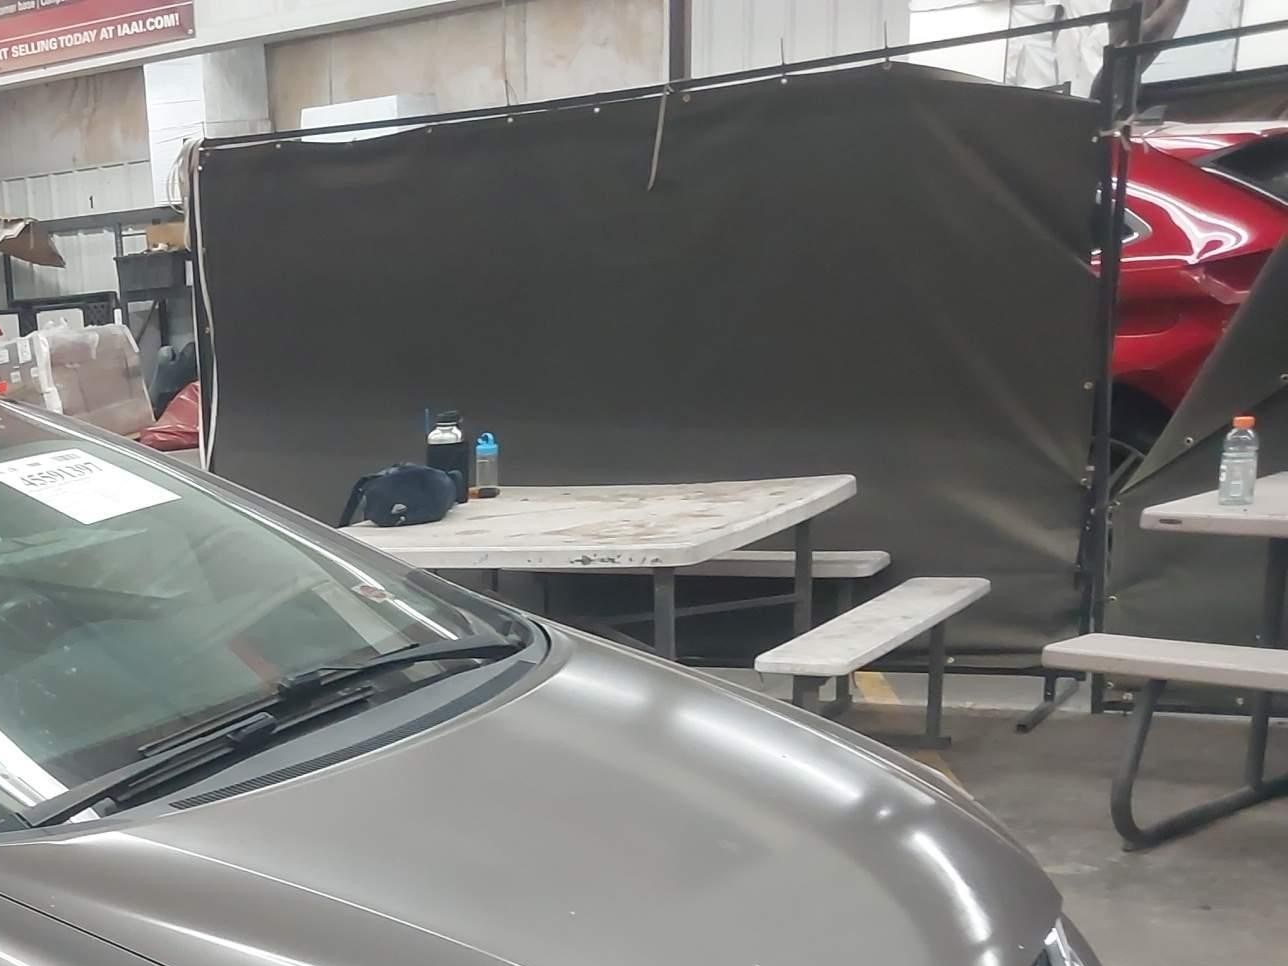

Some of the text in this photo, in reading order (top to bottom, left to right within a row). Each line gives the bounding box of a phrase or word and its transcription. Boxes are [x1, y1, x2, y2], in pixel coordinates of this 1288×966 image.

[11, 37, 58, 58] SELLING
[59, 29, 98, 49] TODAY
[100, 25, 116, 41] AT
[117, 13, 180, 37] IAAI.COM!
[20, 461, 103, 487] 45591397
